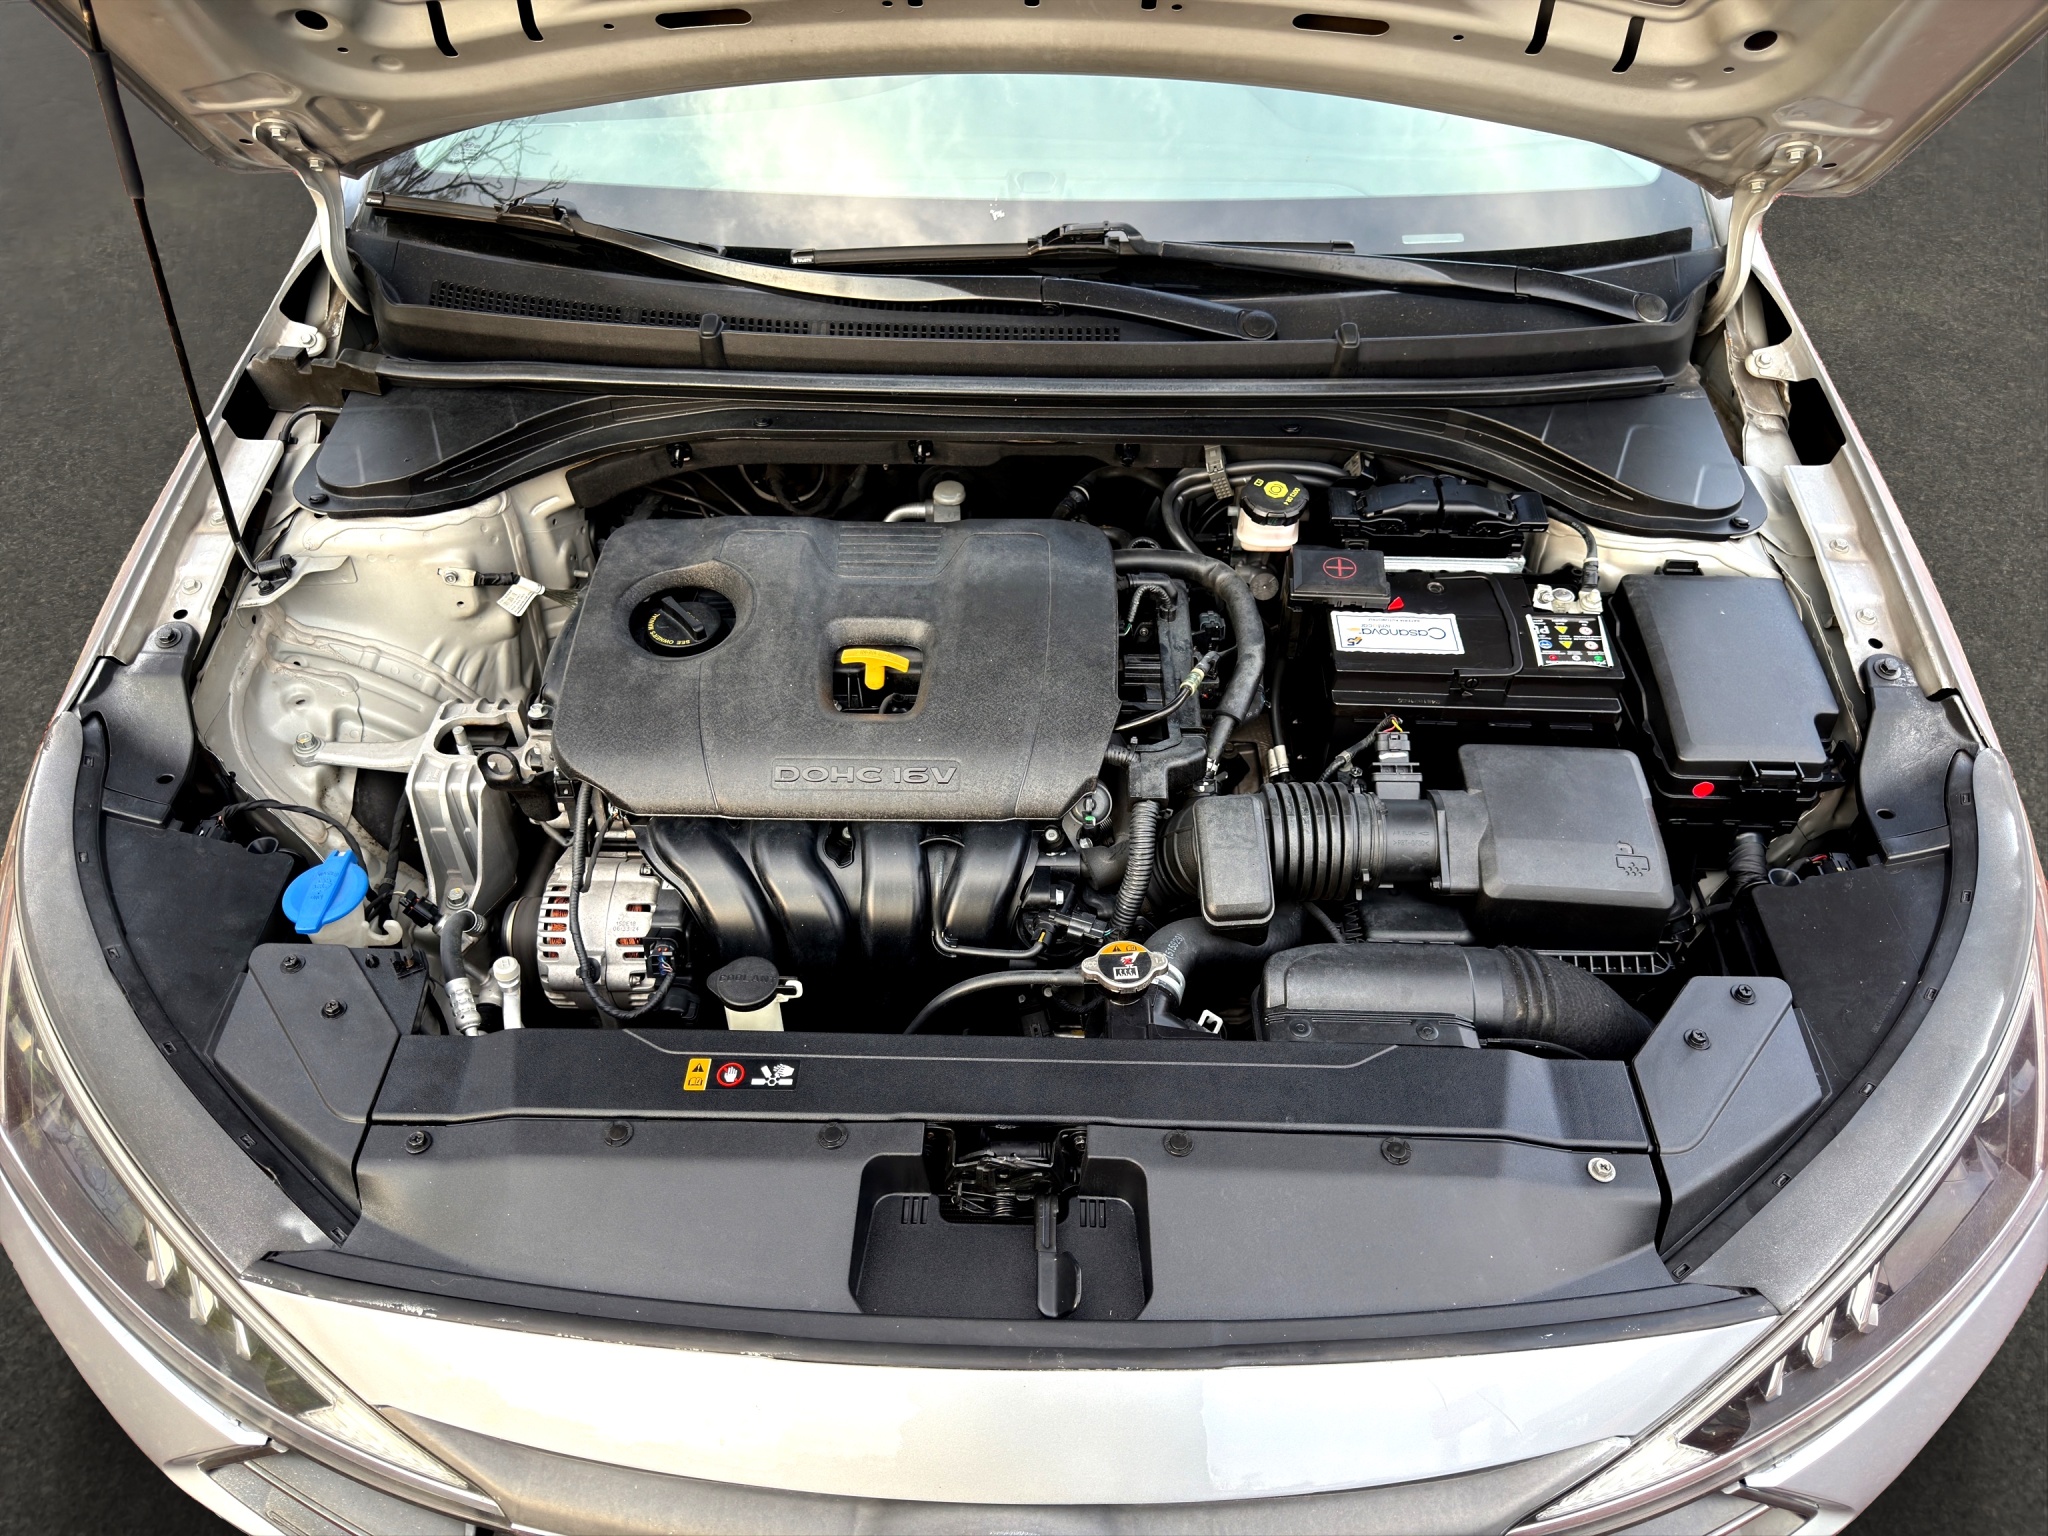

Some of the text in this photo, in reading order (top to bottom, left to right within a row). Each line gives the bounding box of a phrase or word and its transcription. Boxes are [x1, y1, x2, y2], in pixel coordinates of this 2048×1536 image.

[1361, 627, 1446, 640] Casanova
[774, 765, 957, 784] DOHC 16V
